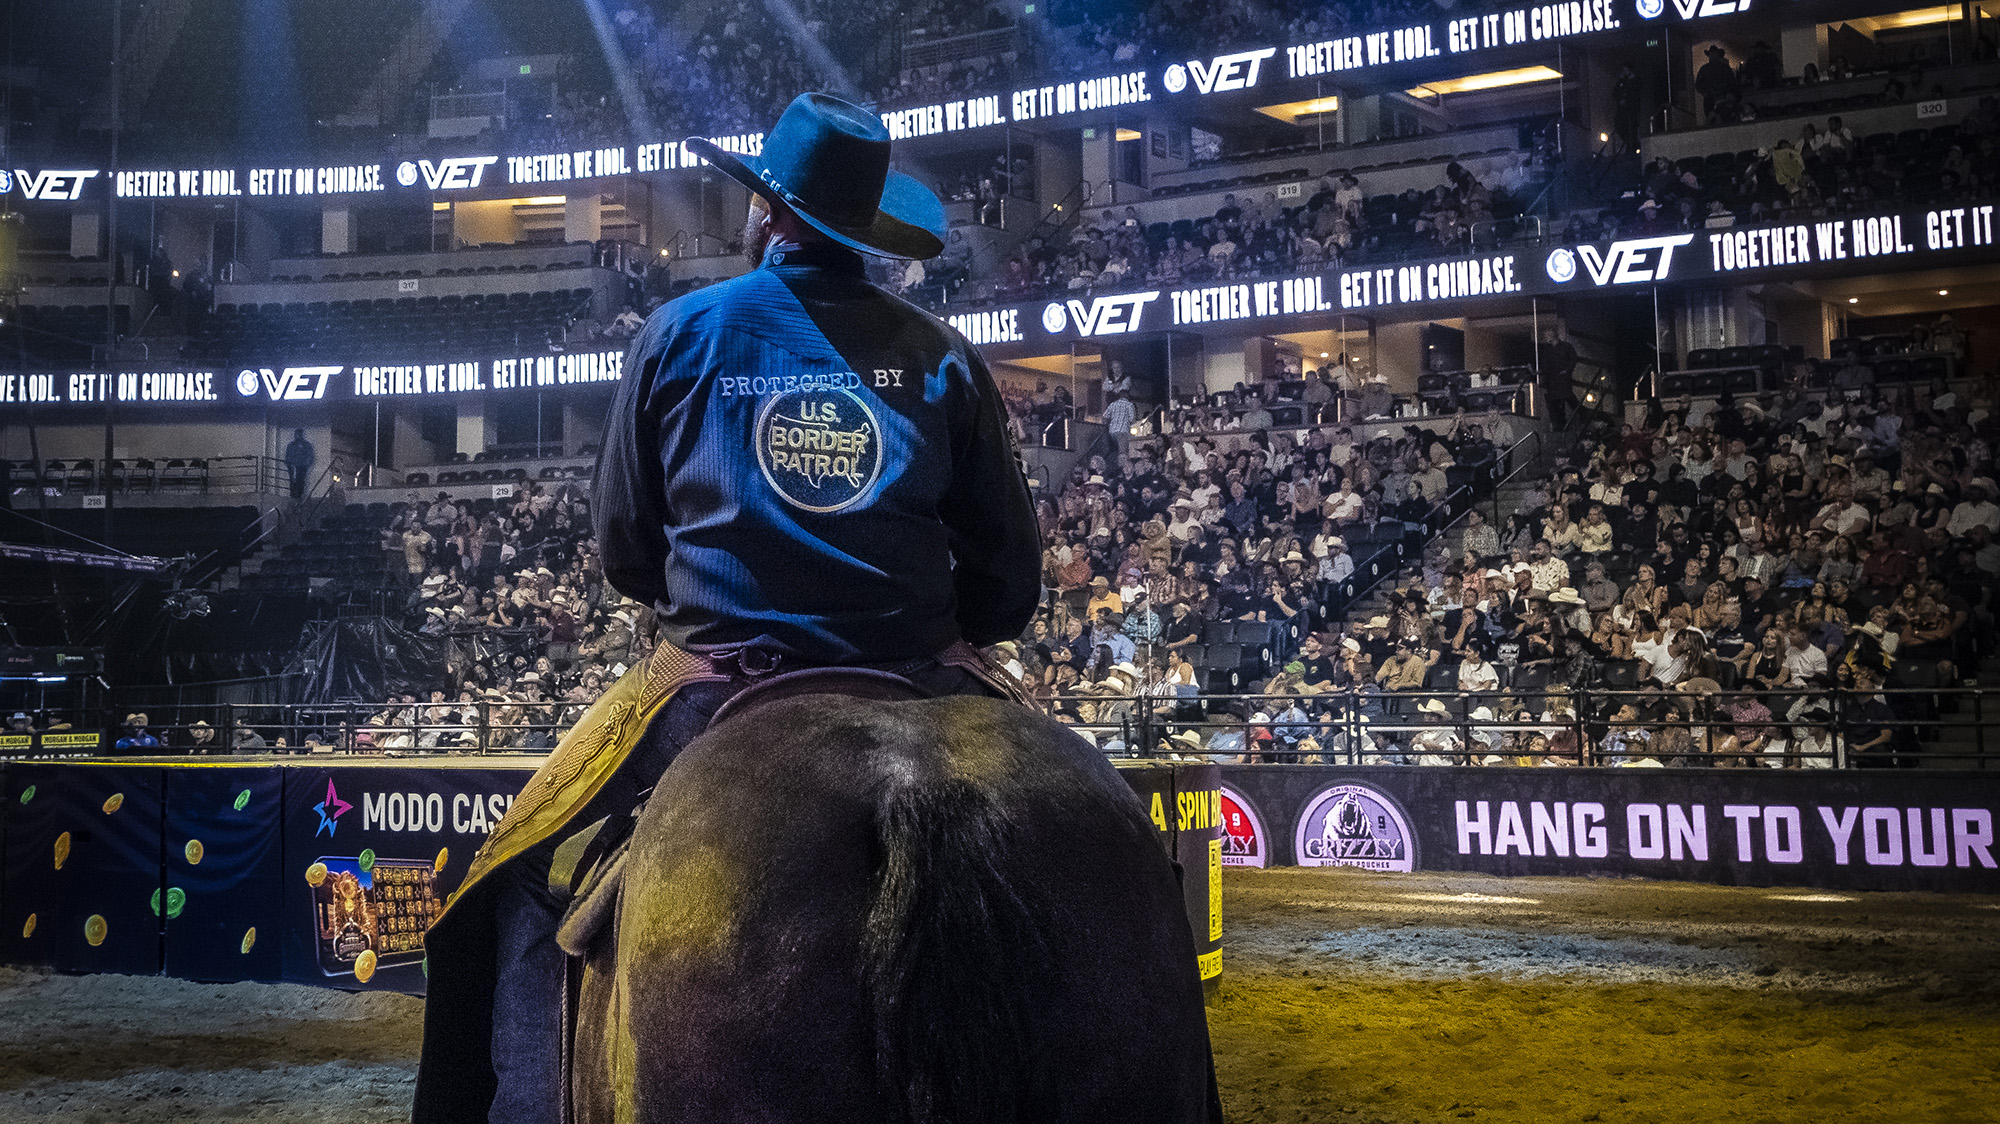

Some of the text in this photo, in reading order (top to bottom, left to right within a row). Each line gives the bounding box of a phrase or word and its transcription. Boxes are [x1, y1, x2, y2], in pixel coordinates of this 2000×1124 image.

[1187, 47, 1276, 94] VET
[1287, 36, 1363, 78] TOGETHER
[1366, 32, 1389, 65] WE
[1449, 17, 1478, 53] GET
[1482, 13, 1499, 48] IT
[1504, 9, 1526, 45] ON
[1531, 0, 1620, 41] COINBASE.
[881, 105, 943, 140] TOGETHER
[946, 101, 965, 131] WE
[1012, 88, 1037, 121] GET
[1040, 86, 1054, 117] IT
[1057, 83, 1076, 114] ON
[1079, 72, 1151, 110] COINBASE.
[1921, 104, 1943, 115] 320
[418, 156, 499, 190] VET
[507, 153, 571, 184] TOGETHER
[573, 150, 592, 179] WE
[637, 143, 662, 173] GET
[664, 141, 677, 170] IT
[14, 169, 99, 200] VET
[109, 171, 175, 197] OGETHER
[179, 170, 199, 196] WE
[250, 168, 275, 196] GET
[278, 168, 292, 195] IT
[296, 167, 314, 195] ON
[318, 165, 385, 194] COINBASE.
[1280, 185, 1297, 195] 319
[1577, 206, 1994, 286] VET TOGETHER WE HODL. GET IT
[402, 282, 415, 290] 317
[1067, 291, 1160, 337] VET
[1171, 285, 1250, 325] TOGETHER
[1254, 282, 1278, 317] WE
[1340, 272, 1371, 309] GET
[1376, 269, 1394, 305] IT
[1399, 266, 1421, 303] ON
[1427, 256, 1521, 300] COINBASE.
[69, 373, 96, 401] GET
[118, 373, 137, 401] ON
[142, 372, 218, 401] COINBASE.
[259, 366, 344, 400] VET
[353, 366, 422, 396] TOGETHER
[426, 364, 445, 394] WE
[493, 359, 517, 389] GET
[520, 357, 534, 387] IT
[536, 356, 554, 386] ON
[720, 369, 904, 397] PROTECTED BY
[800, 401, 841, 423] U.S.
[771, 426, 867, 454] BORDER
[772, 451, 864, 478] PATROL
[495, 487, 509, 496] 219
[1330, 786, 1368, 795] ORIGINAL
[363, 793, 444, 832] MODO
[1177, 790, 1209, 831] SPIN
[1232, 813, 1241, 827] 9
[1378, 816, 1386, 829] 9
[1456, 800, 1999, 869] HANG ON TO YOUR
[1305, 838, 1401, 860] GRIZZLY
[1356, 861, 1390, 869] POUCHES
